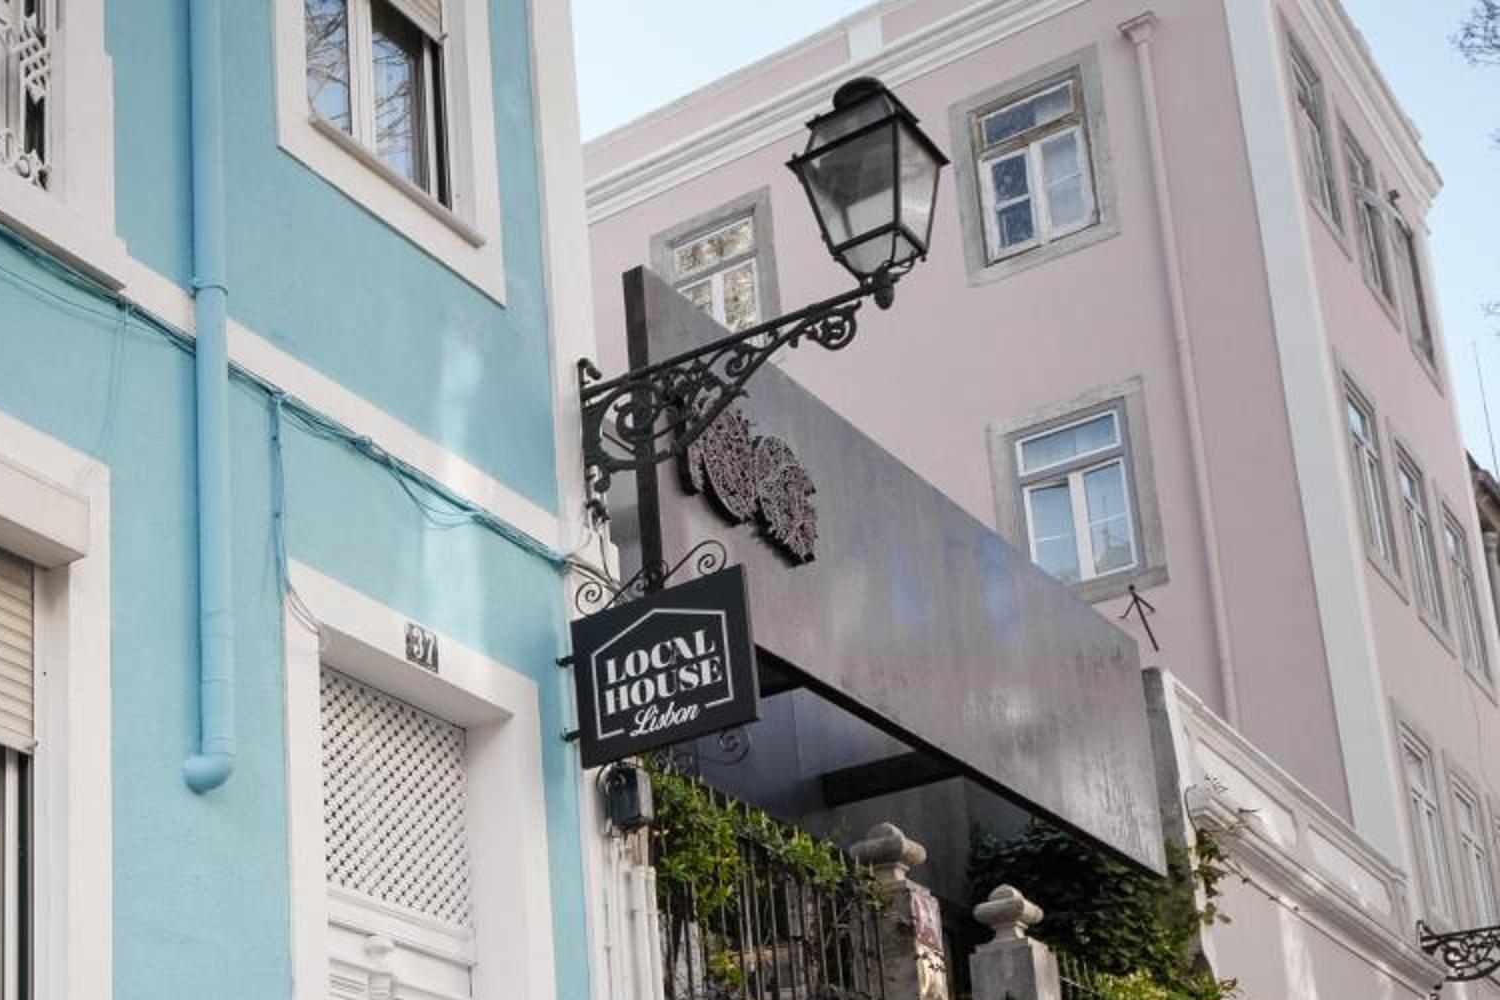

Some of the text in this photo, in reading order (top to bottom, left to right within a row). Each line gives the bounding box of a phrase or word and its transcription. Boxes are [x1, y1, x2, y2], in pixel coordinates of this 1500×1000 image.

[605, 629, 715, 685] LOCAL
[604, 656, 723, 715] HOUSE
[629, 701, 701, 737] Lisbon
